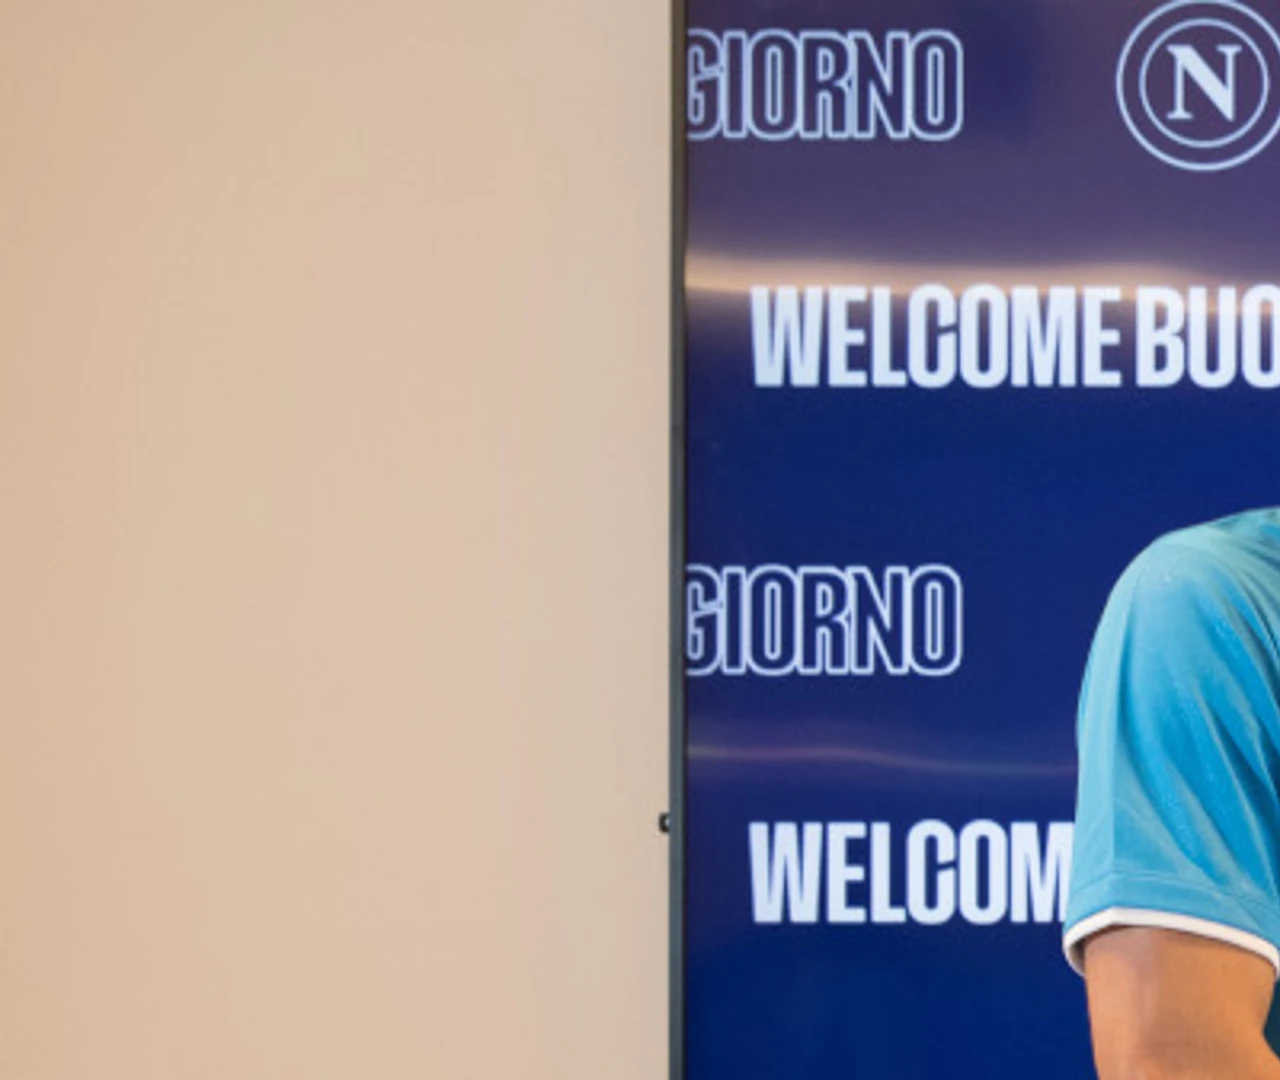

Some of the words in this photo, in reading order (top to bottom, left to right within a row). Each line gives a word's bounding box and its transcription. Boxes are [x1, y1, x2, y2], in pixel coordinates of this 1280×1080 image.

[687, 28, 964, 141] GIORNO
[1166, 44, 1242, 122] N
[749, 283, 1122, 388] WELCOME
[687, 563, 963, 676] GIORNO
[749, 819, 1074, 925] WELCOM
